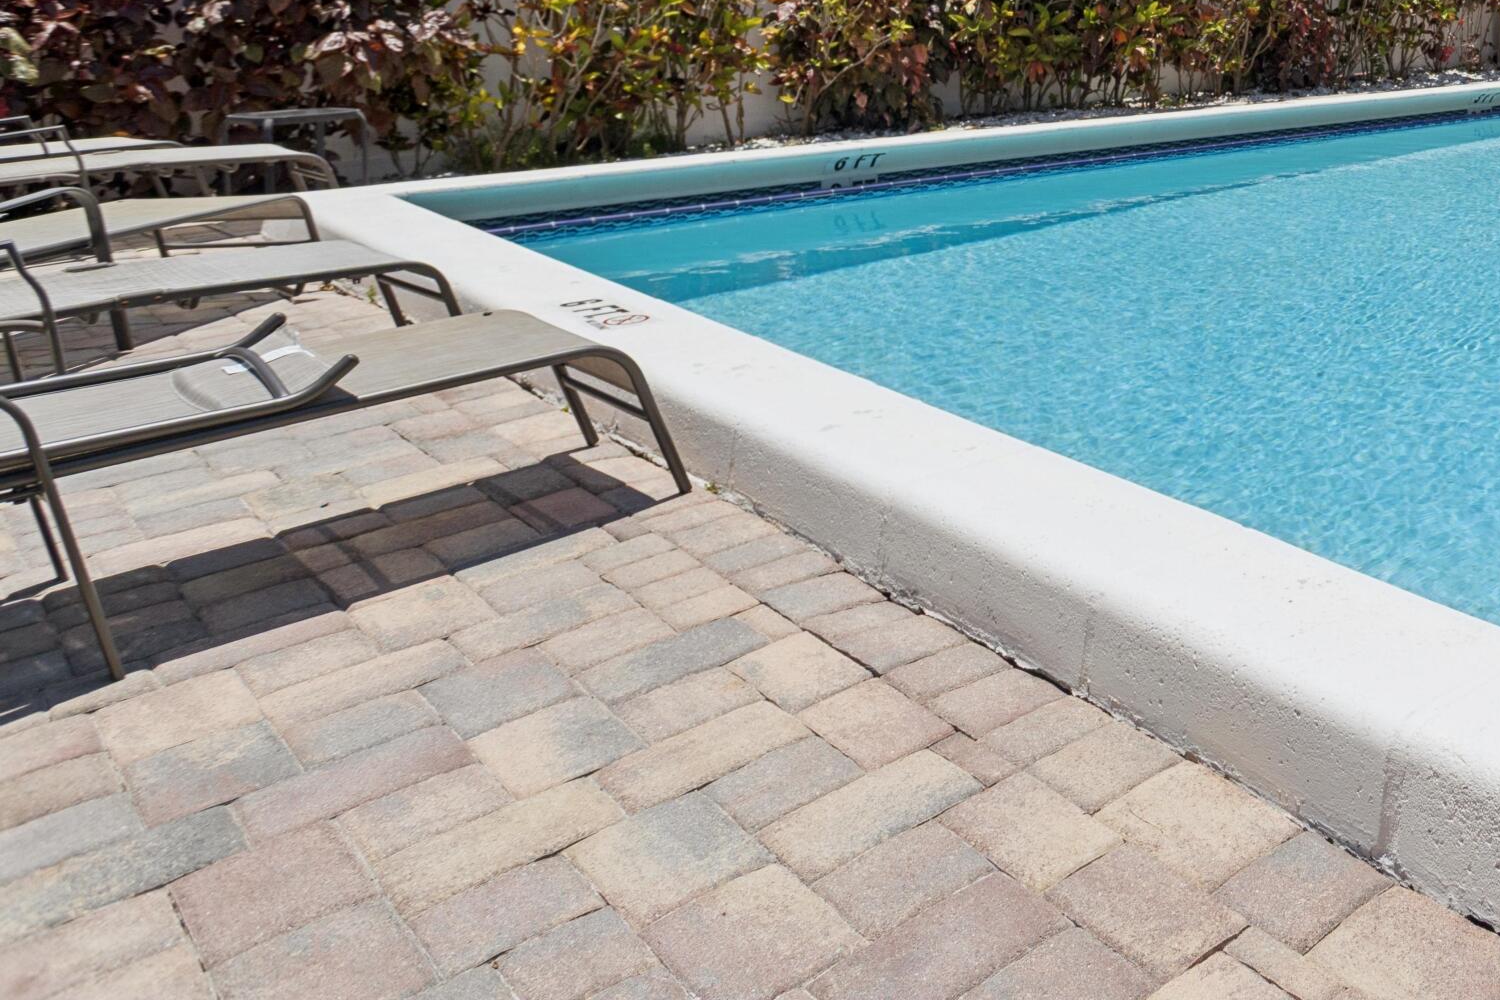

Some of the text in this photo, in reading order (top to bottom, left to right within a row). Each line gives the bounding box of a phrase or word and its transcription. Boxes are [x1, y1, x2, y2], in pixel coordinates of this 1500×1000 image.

[834, 152, 886, 171] 6 FT
[559, 298, 630, 319] 6 FT
